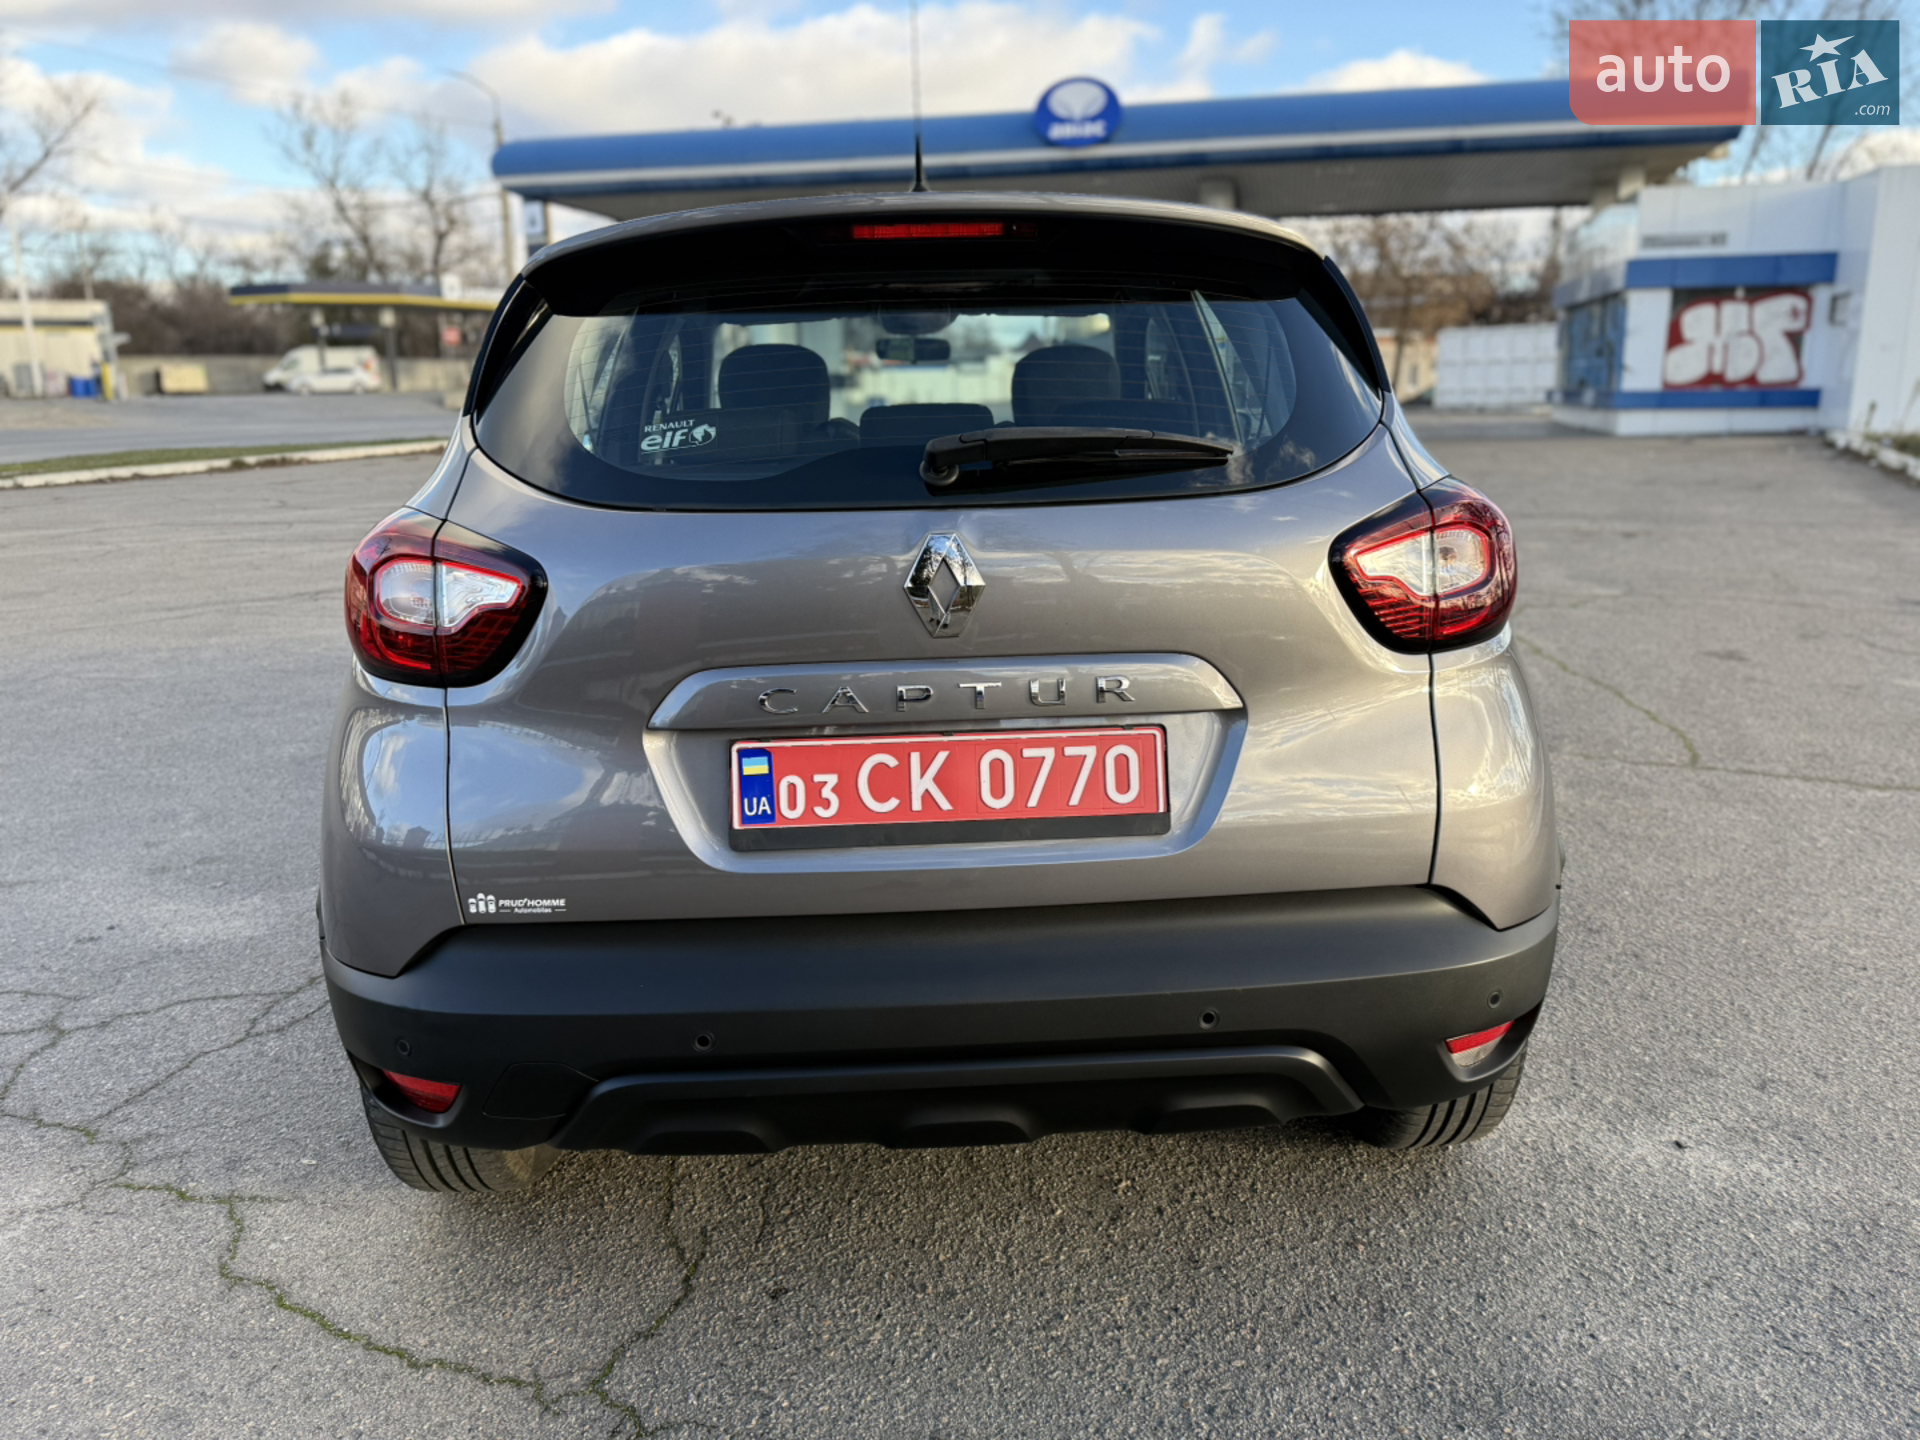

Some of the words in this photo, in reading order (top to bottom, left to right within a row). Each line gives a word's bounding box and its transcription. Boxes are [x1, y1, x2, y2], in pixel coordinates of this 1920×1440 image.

[644, 419, 695, 432] RENAULT
[641, 429, 688, 451] elf
[757, 675, 1135, 714] CAPTUR
[778, 774, 839, 820] 03
[857, 750, 953, 814] CK
[979, 744, 1140, 810] 0770
[743, 796, 772, 817] UA
